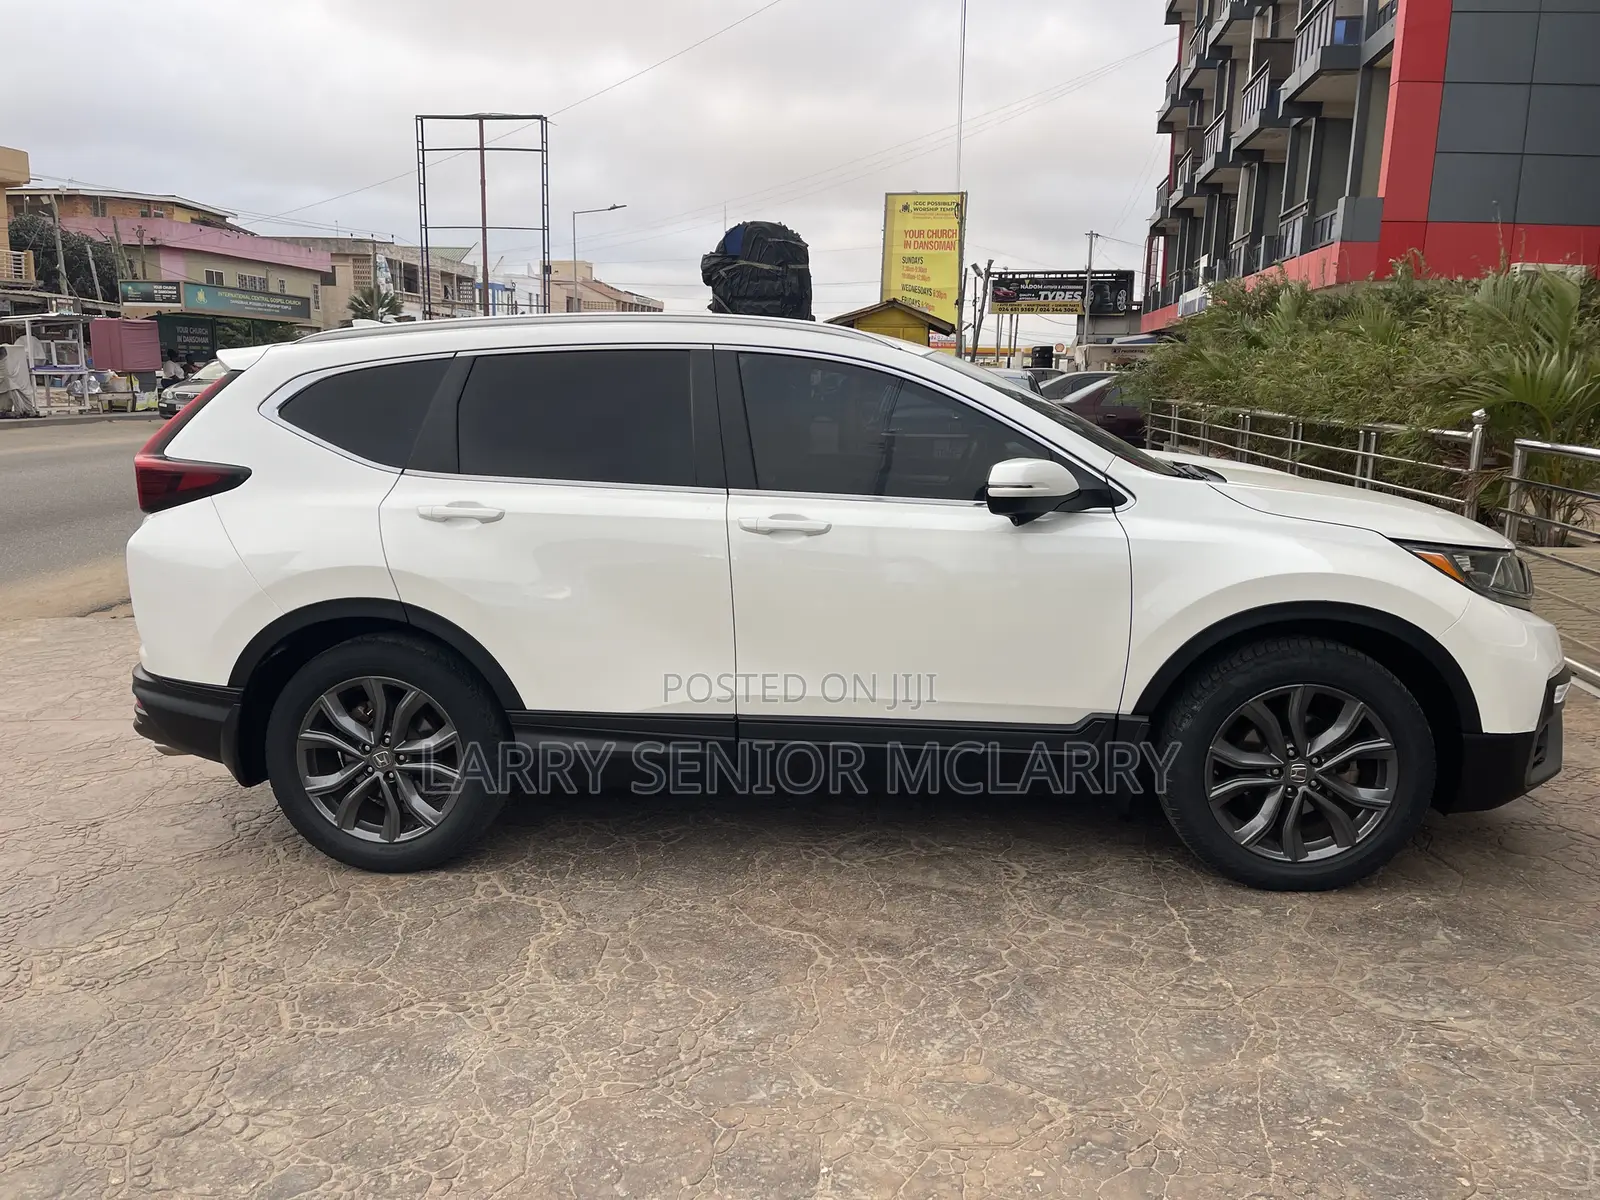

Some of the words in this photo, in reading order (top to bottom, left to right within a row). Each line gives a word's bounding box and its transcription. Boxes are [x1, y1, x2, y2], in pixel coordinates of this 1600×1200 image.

[903, 229, 925, 239] YOUR
[926, 229, 958, 239] CHURCH
[903, 240, 912, 249] IN
[913, 240, 956, 251] DANSOMAN
[901, 256, 924, 265] SUNDAYS
[901, 283, 933, 297] WEDNESDAYS
[218, 291, 250, 300] INTERNATIONAL
[1038, 290, 1082, 301] TYRES
[190, 327, 209, 335] CHURCH
